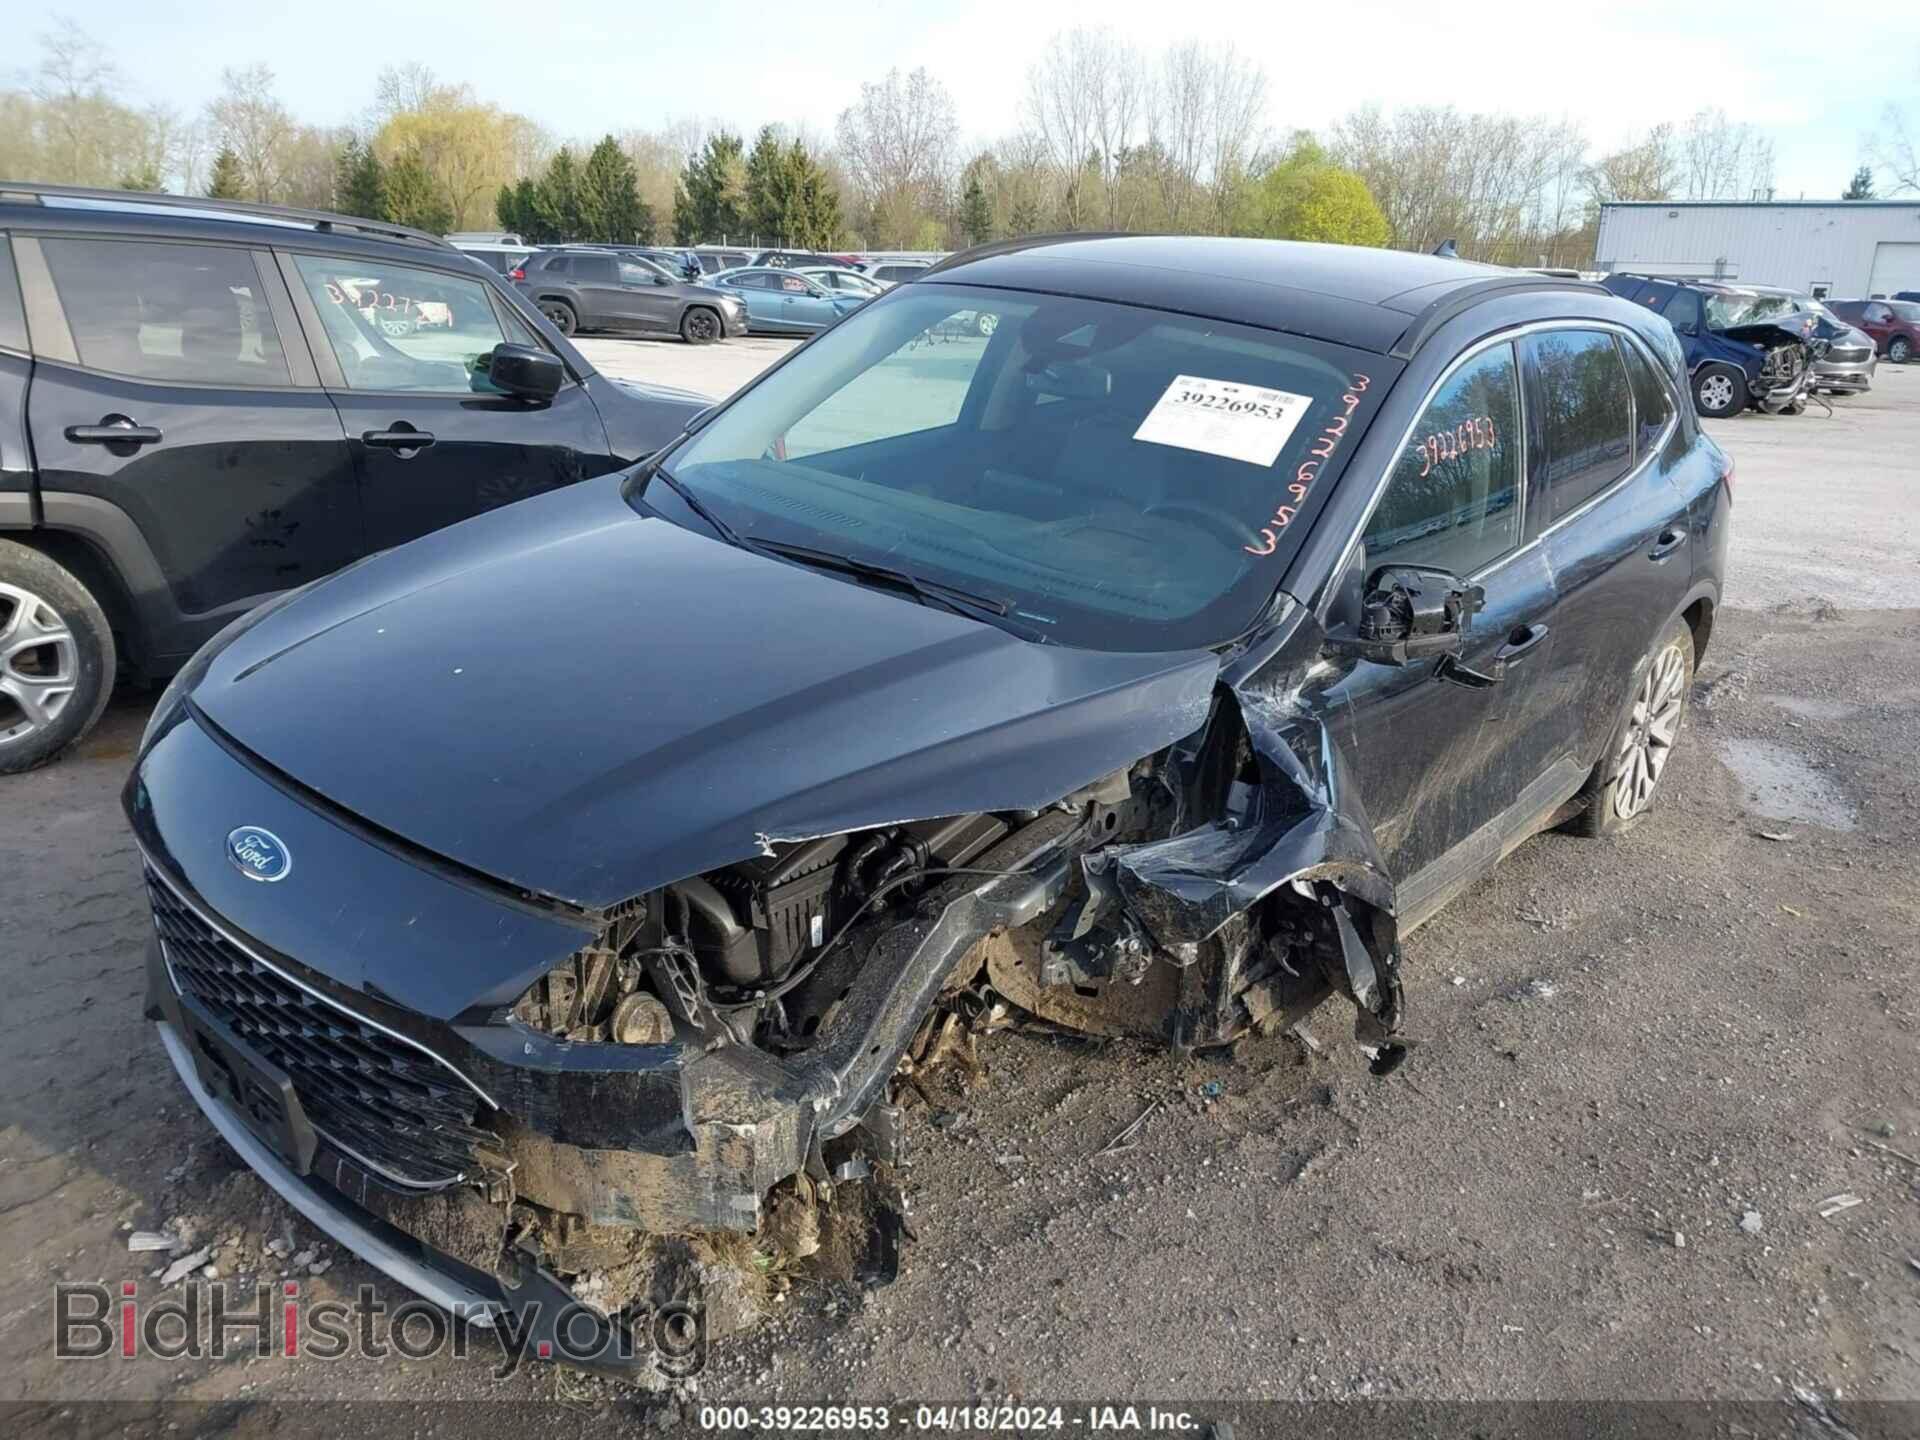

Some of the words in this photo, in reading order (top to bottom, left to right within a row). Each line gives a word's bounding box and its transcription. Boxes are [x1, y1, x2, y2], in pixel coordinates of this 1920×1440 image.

[1173, 390, 1285, 421] 39226953
[1243, 373, 1371, 556] 39226953
[1415, 415, 1495, 477] 39226953
[234, 834, 275, 870] Ford
